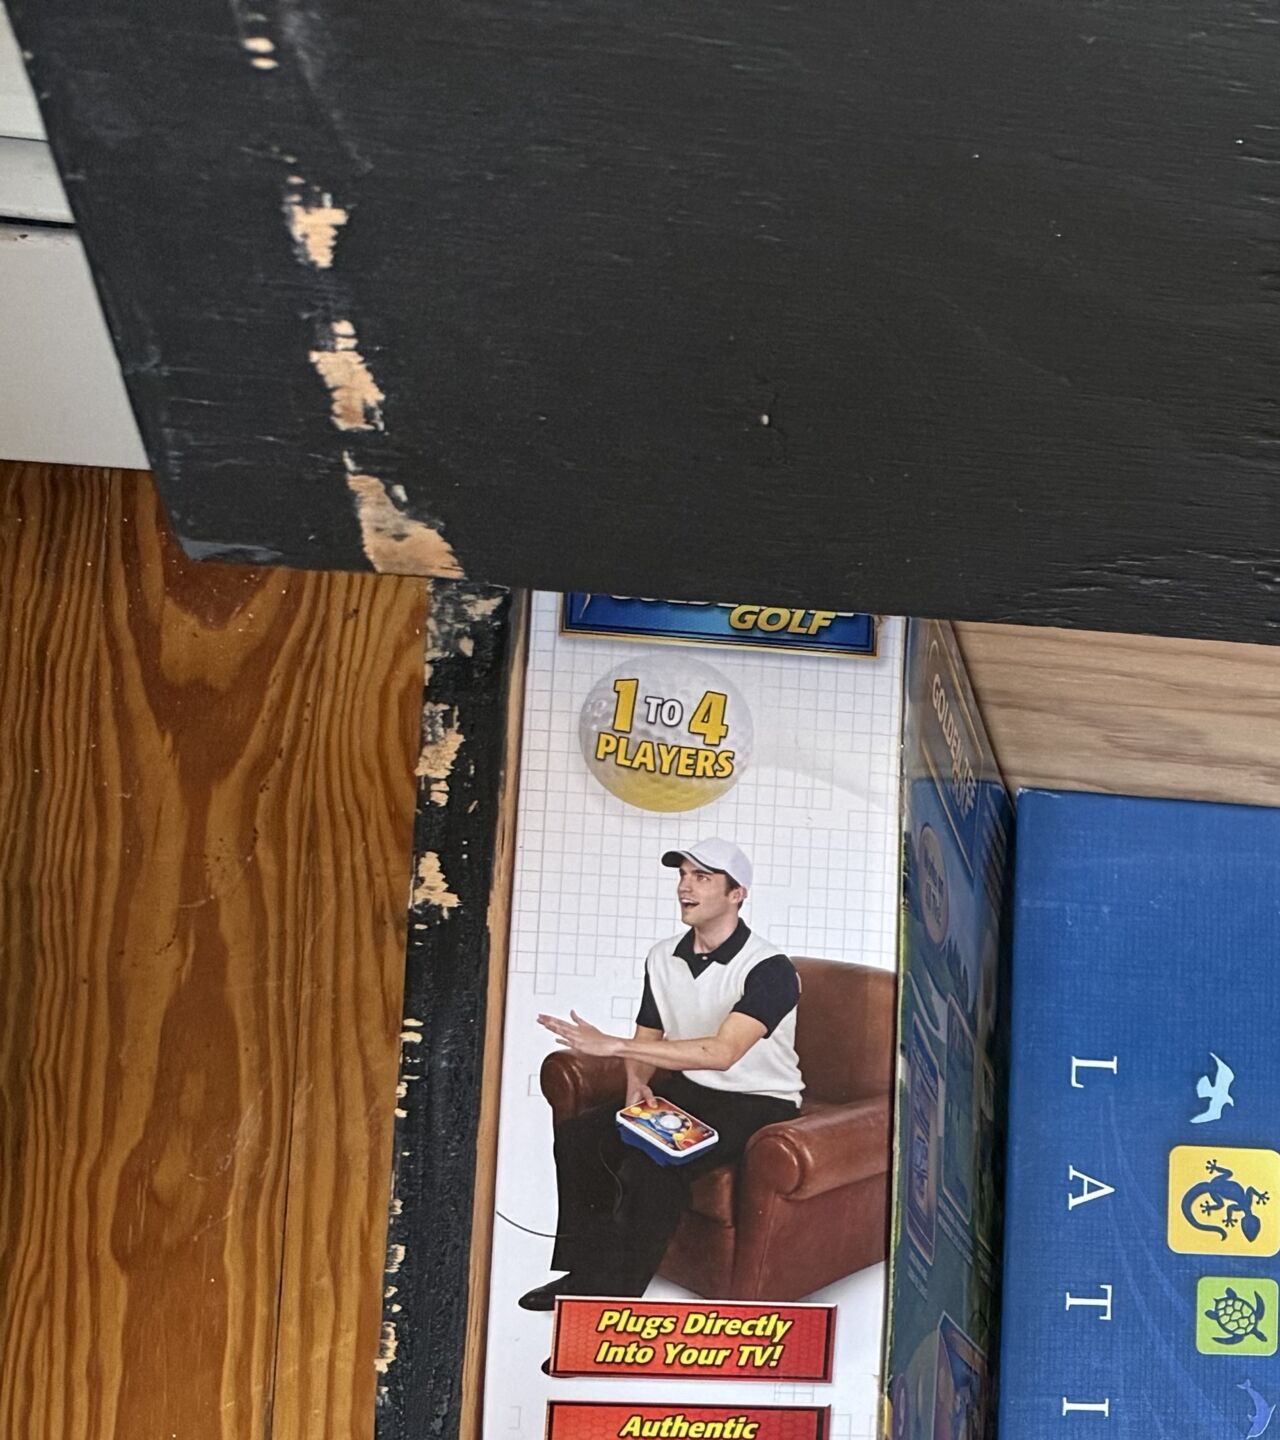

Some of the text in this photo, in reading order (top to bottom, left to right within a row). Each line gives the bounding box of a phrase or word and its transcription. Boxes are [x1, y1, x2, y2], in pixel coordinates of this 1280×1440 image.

[729, 604, 836, 635] GOLF
[612, 677, 729, 746] 1 TO 4
[595, 731, 736, 779] PLAYERS
[596, 1308, 793, 1343] Plugs Directly
[594, 1340, 783, 1368] Into Your TV!
[618, 1415, 759, 1440] Authentic
